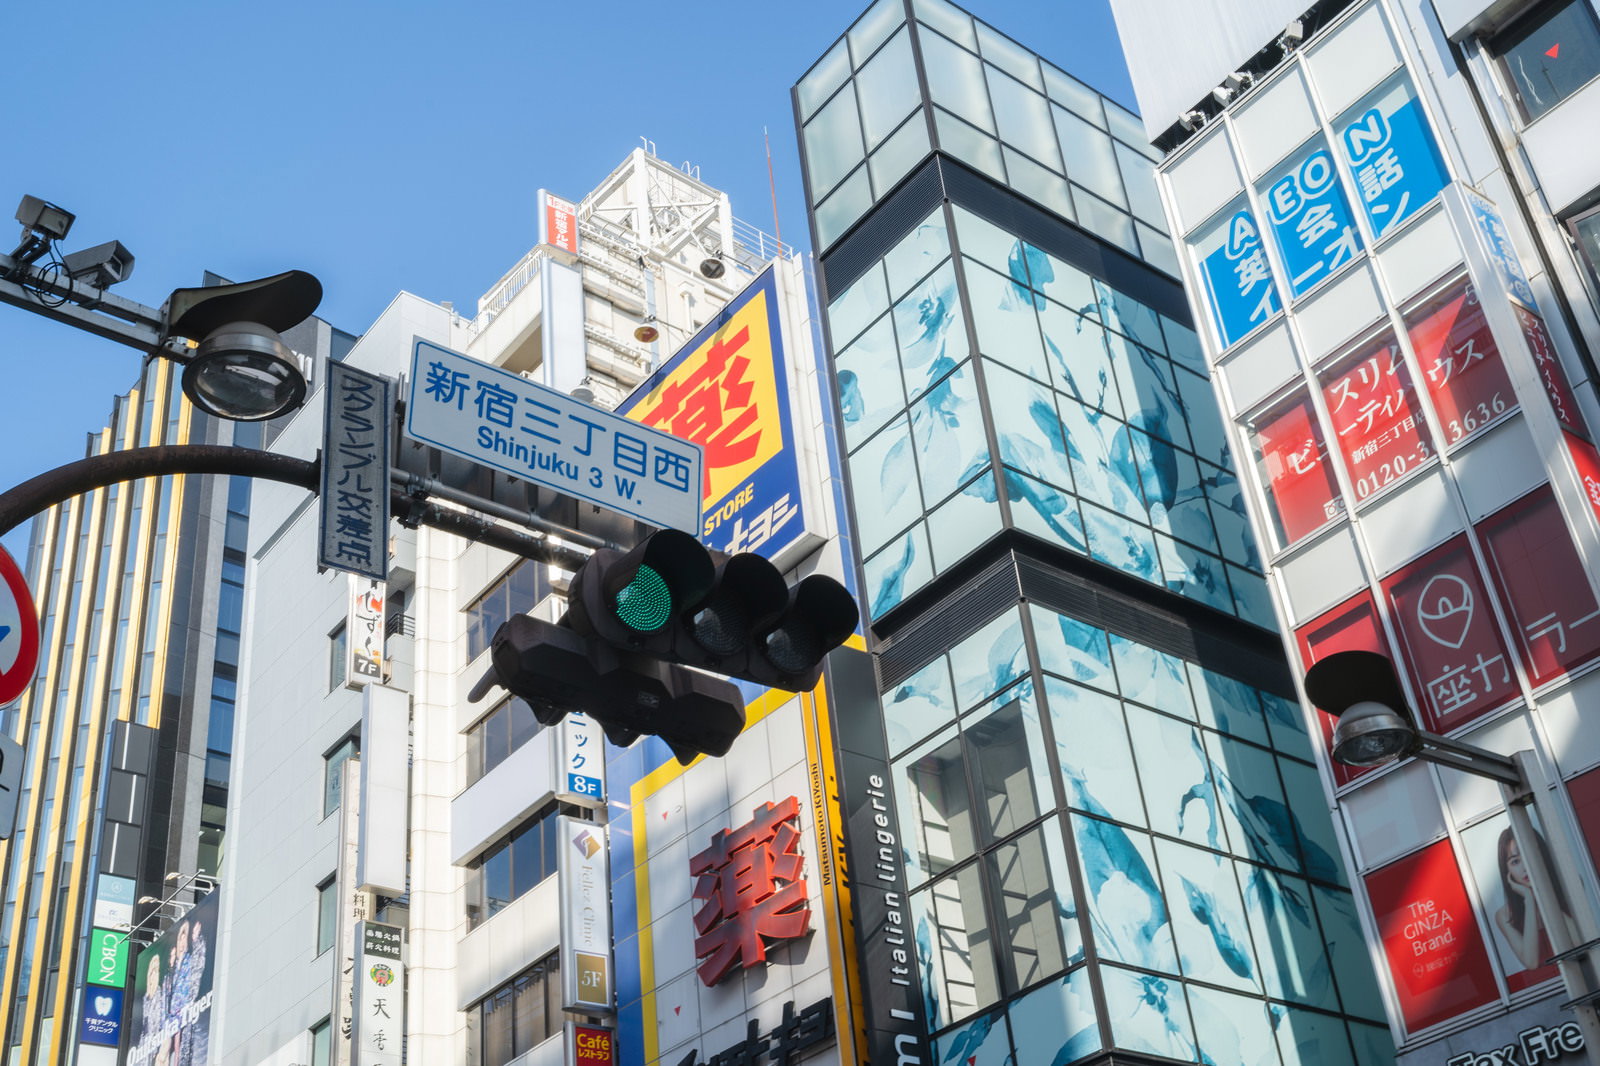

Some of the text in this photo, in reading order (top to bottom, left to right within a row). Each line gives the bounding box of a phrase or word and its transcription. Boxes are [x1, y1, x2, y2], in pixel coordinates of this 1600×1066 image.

[1226, 109, 1392, 259] AEON
[1234, 147, 1404, 297] 英会話
[1250, 191, 1410, 322] イーオン
[425, 361, 692, 493] 新宿三丁目西
[336, 374, 375, 567] スクランブル交差点
[477, 426, 643, 505] Shinjuku 3 W.
[704, 482, 755, 537] STORE
[358, 659, 378, 674] 7F
[573, 776, 597, 794] 8F
[817, 811, 832, 886] Matsumoto
[866, 774, 911, 986] Italian lingerie
[1404, 910, 1453, 940] GINZA
[1407, 899, 1435, 919] The
[581, 971, 602, 988] 5F
[88, 1025, 114, 1034] クリニック
[179, 990, 213, 1028] Tiger
[577, 1033, 610, 1051] Café
[577, 1048, 610, 1061] レストラン
[1520, 1022, 1585, 1066] Fre
